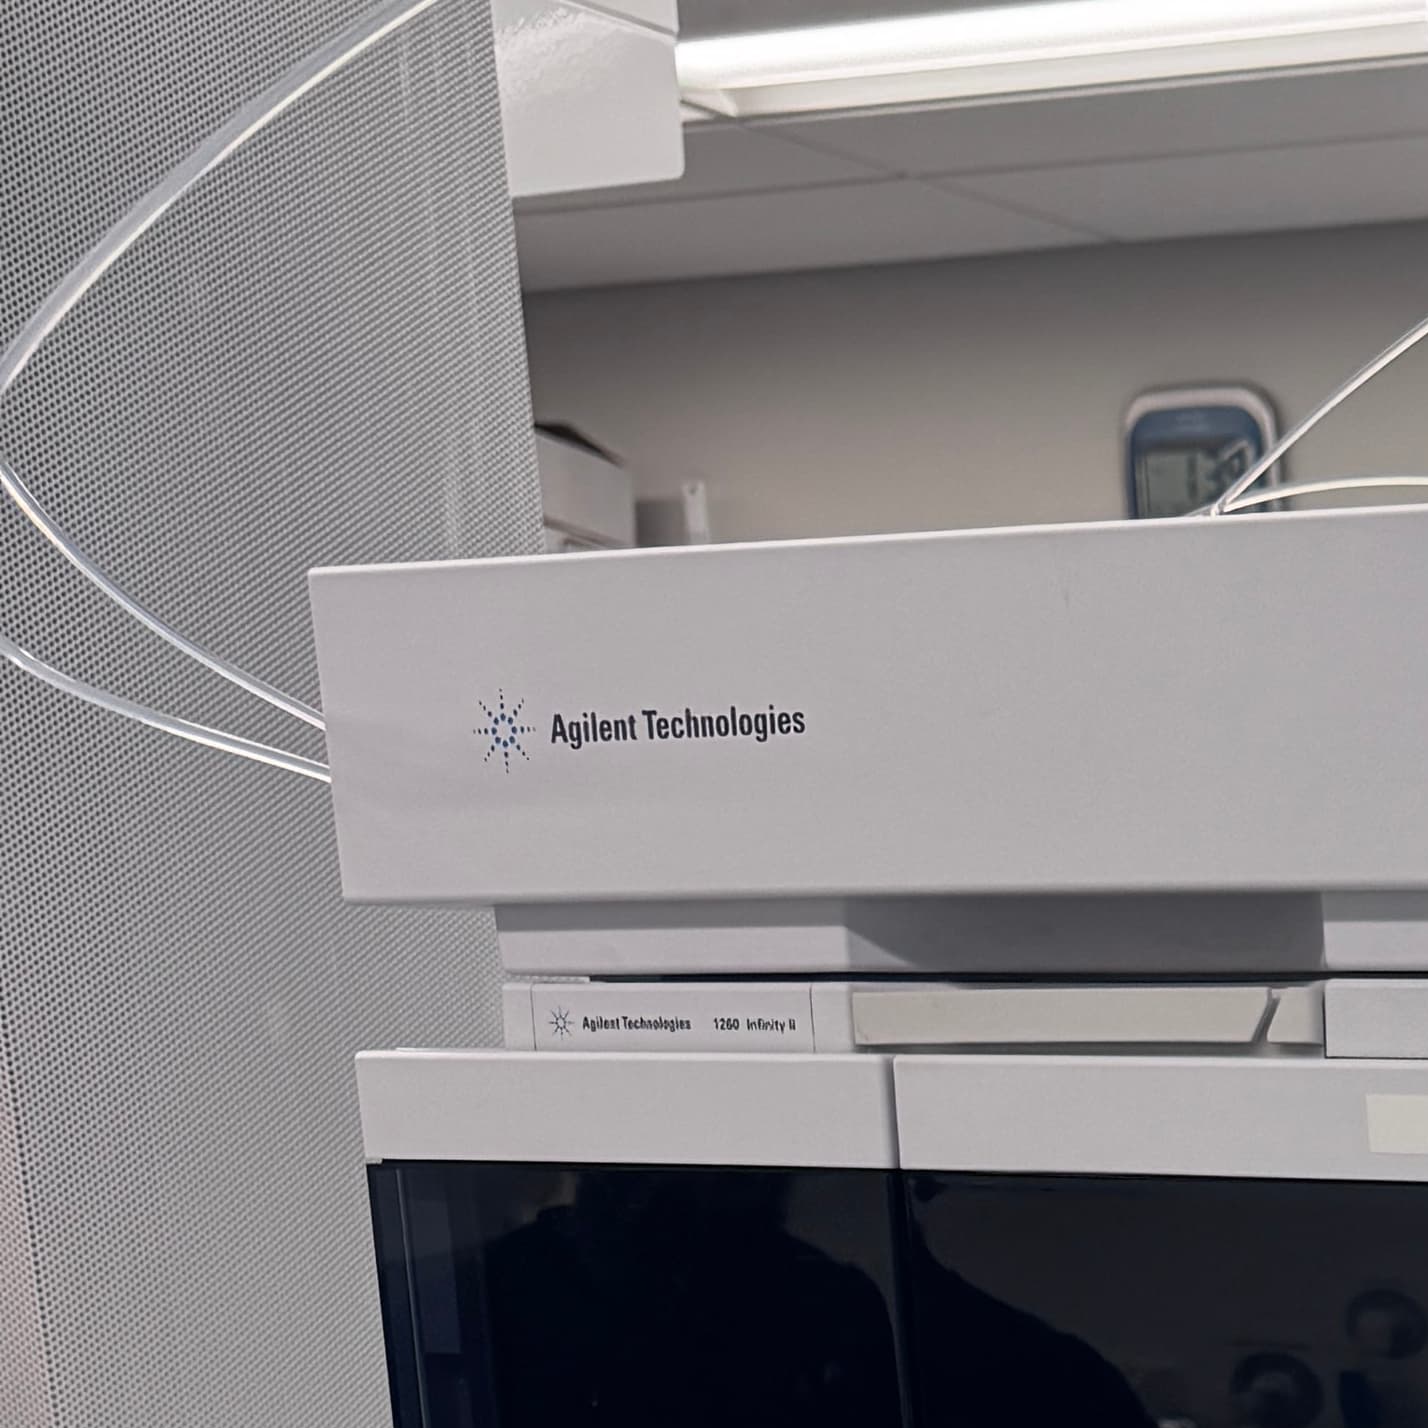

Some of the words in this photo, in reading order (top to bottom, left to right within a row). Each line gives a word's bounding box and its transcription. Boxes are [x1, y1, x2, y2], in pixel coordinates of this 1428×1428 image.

[551, 711, 637, 750] Agilent
[641, 705, 806, 744] Technologies
[583, 1016, 620, 1032] Agilent
[622, 1016, 692, 1033] Technologies
[713, 1017, 740, 1031] 1260
[747, 1018, 786, 1034] Infinity
